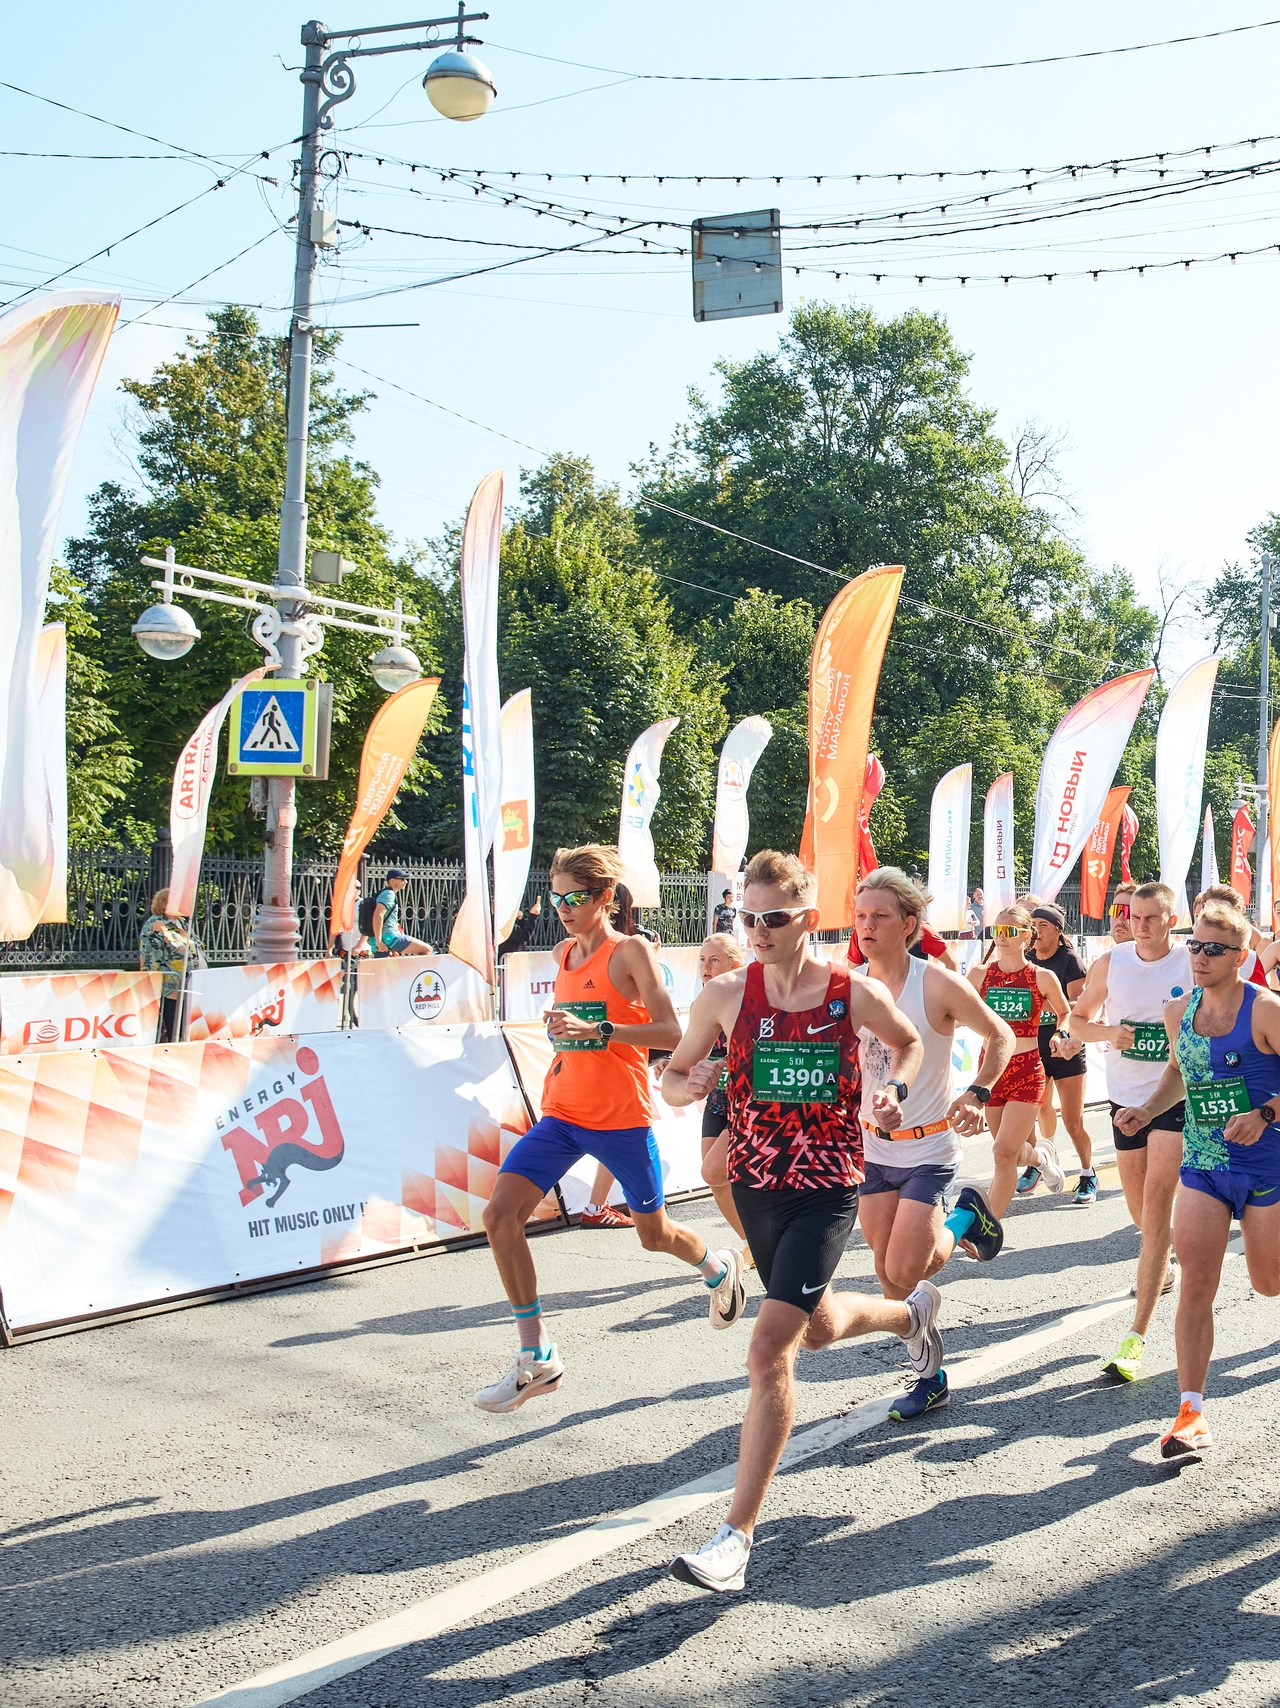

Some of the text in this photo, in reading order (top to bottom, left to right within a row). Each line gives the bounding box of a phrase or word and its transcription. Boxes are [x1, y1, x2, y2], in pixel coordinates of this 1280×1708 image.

[819, 710, 835, 758] ПОЛУ
[829, 674, 851, 760] МАРАФОН
[180, 736, 201, 810] ARTRA
[1057, 751, 1087, 833] НОВЫЙ
[1101, 822, 1111, 855] МАРАФОН
[250, 989, 285, 1036] NRJ
[415, 1002, 440, 1011] RED HILL
[993, 1001, 1024, 1013] 1324
[64, 1013, 138, 1043] DKC
[769, 1067, 836, 1087] 1390 A
[789, 1056, 804, 1066] 5 KM
[214, 1071, 296, 1131] ENERGY
[1199, 1098, 1239, 1115] 1531
[220, 1046, 345, 1208] NRJ
[248, 1218, 271, 1238] HIT
[274, 1210, 320, 1234] MUSIC
[323, 1203, 356, 1225] ONLY
